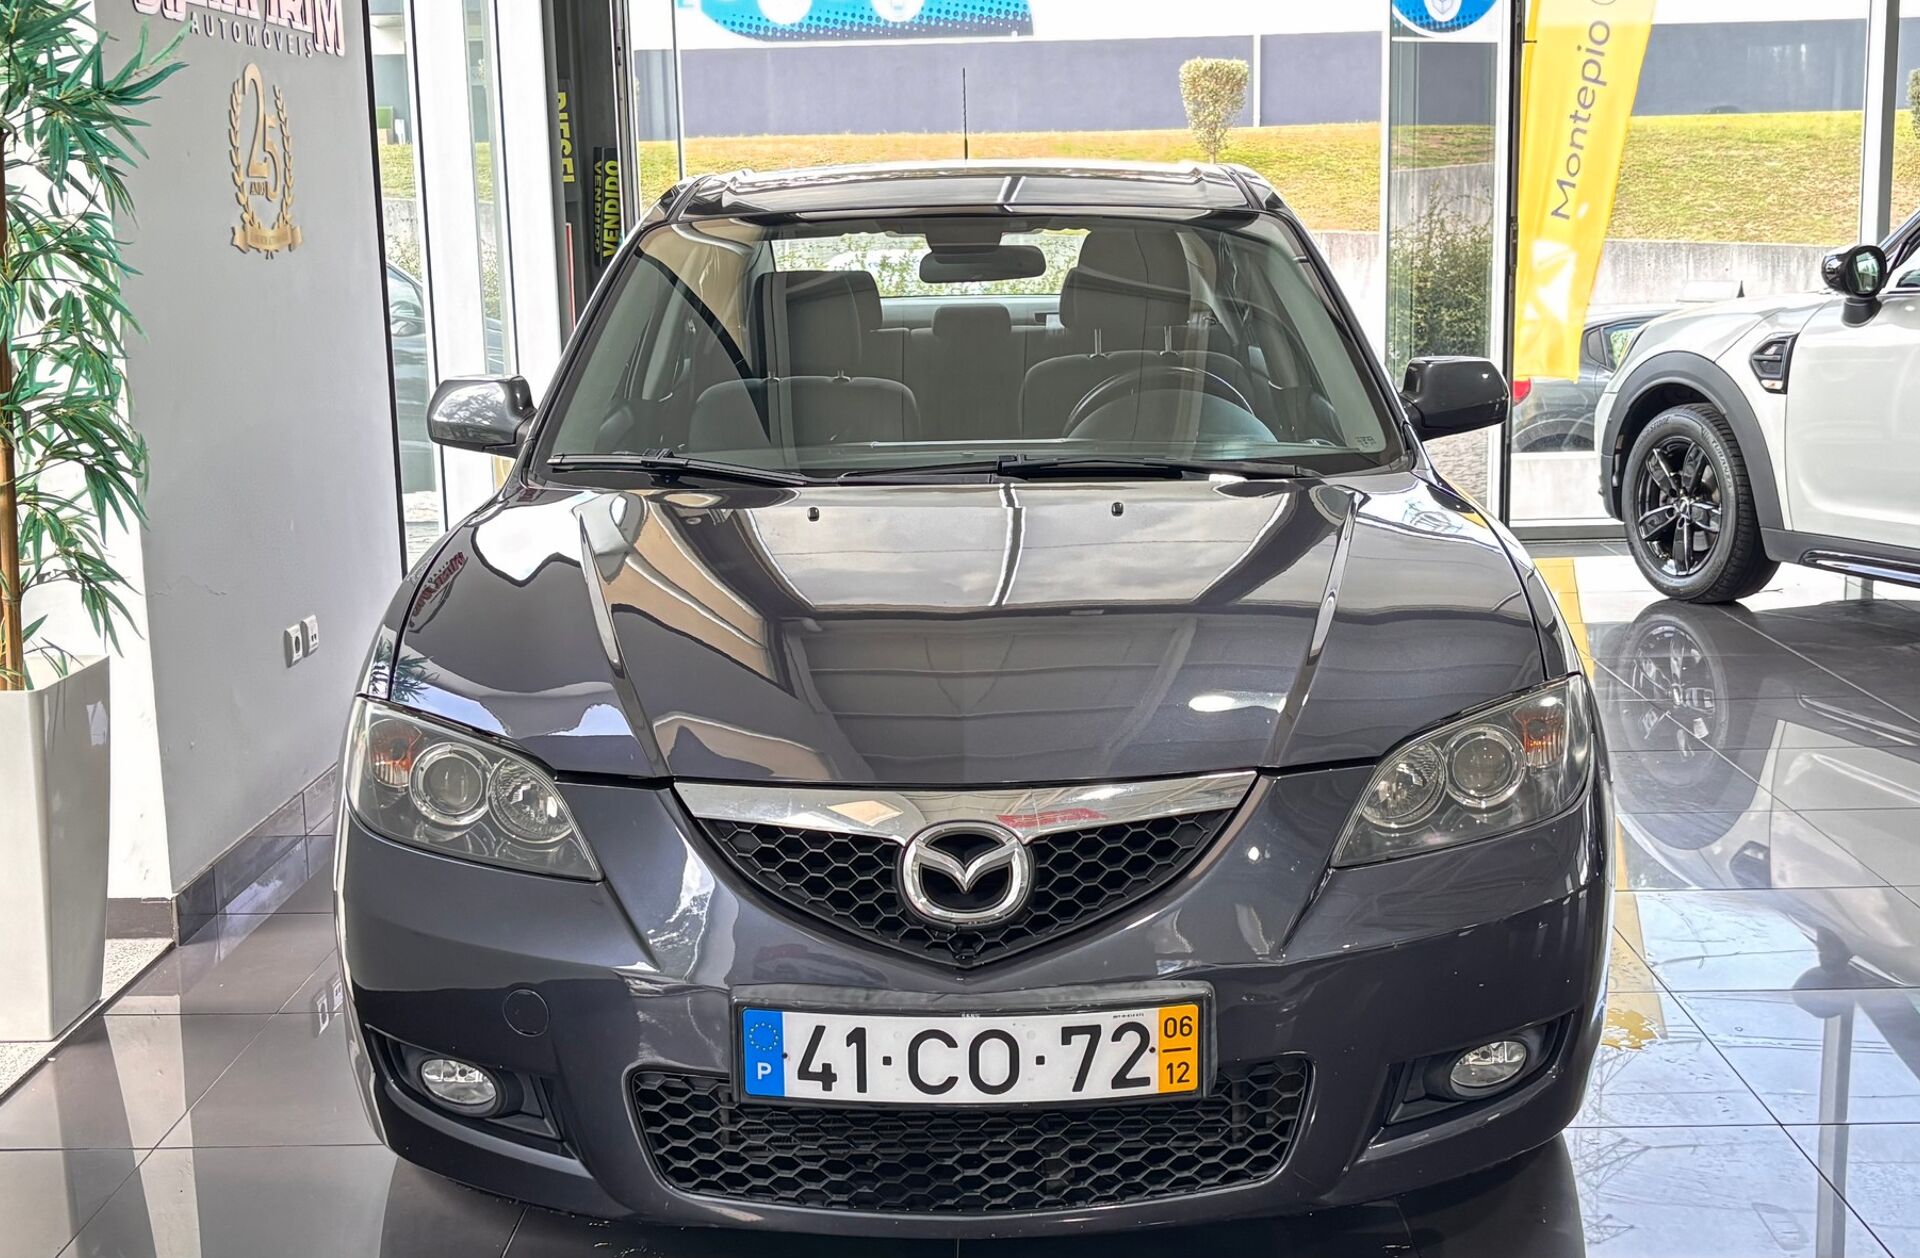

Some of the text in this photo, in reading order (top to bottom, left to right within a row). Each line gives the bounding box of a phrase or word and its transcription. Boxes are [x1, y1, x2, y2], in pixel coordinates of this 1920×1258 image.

[189, 12, 313, 58] AUTOMÓVEIS
[242, 63, 282, 202] 25
[1551, 20, 1611, 220] Montepio
[594, 161, 602, 253] VENDIDO
[603, 160, 620, 257] VENDIDO
[1163, 1016, 1193, 1039] 06
[757, 1062, 772, 1080] P
[1166, 1062, 1191, 1085] 12
